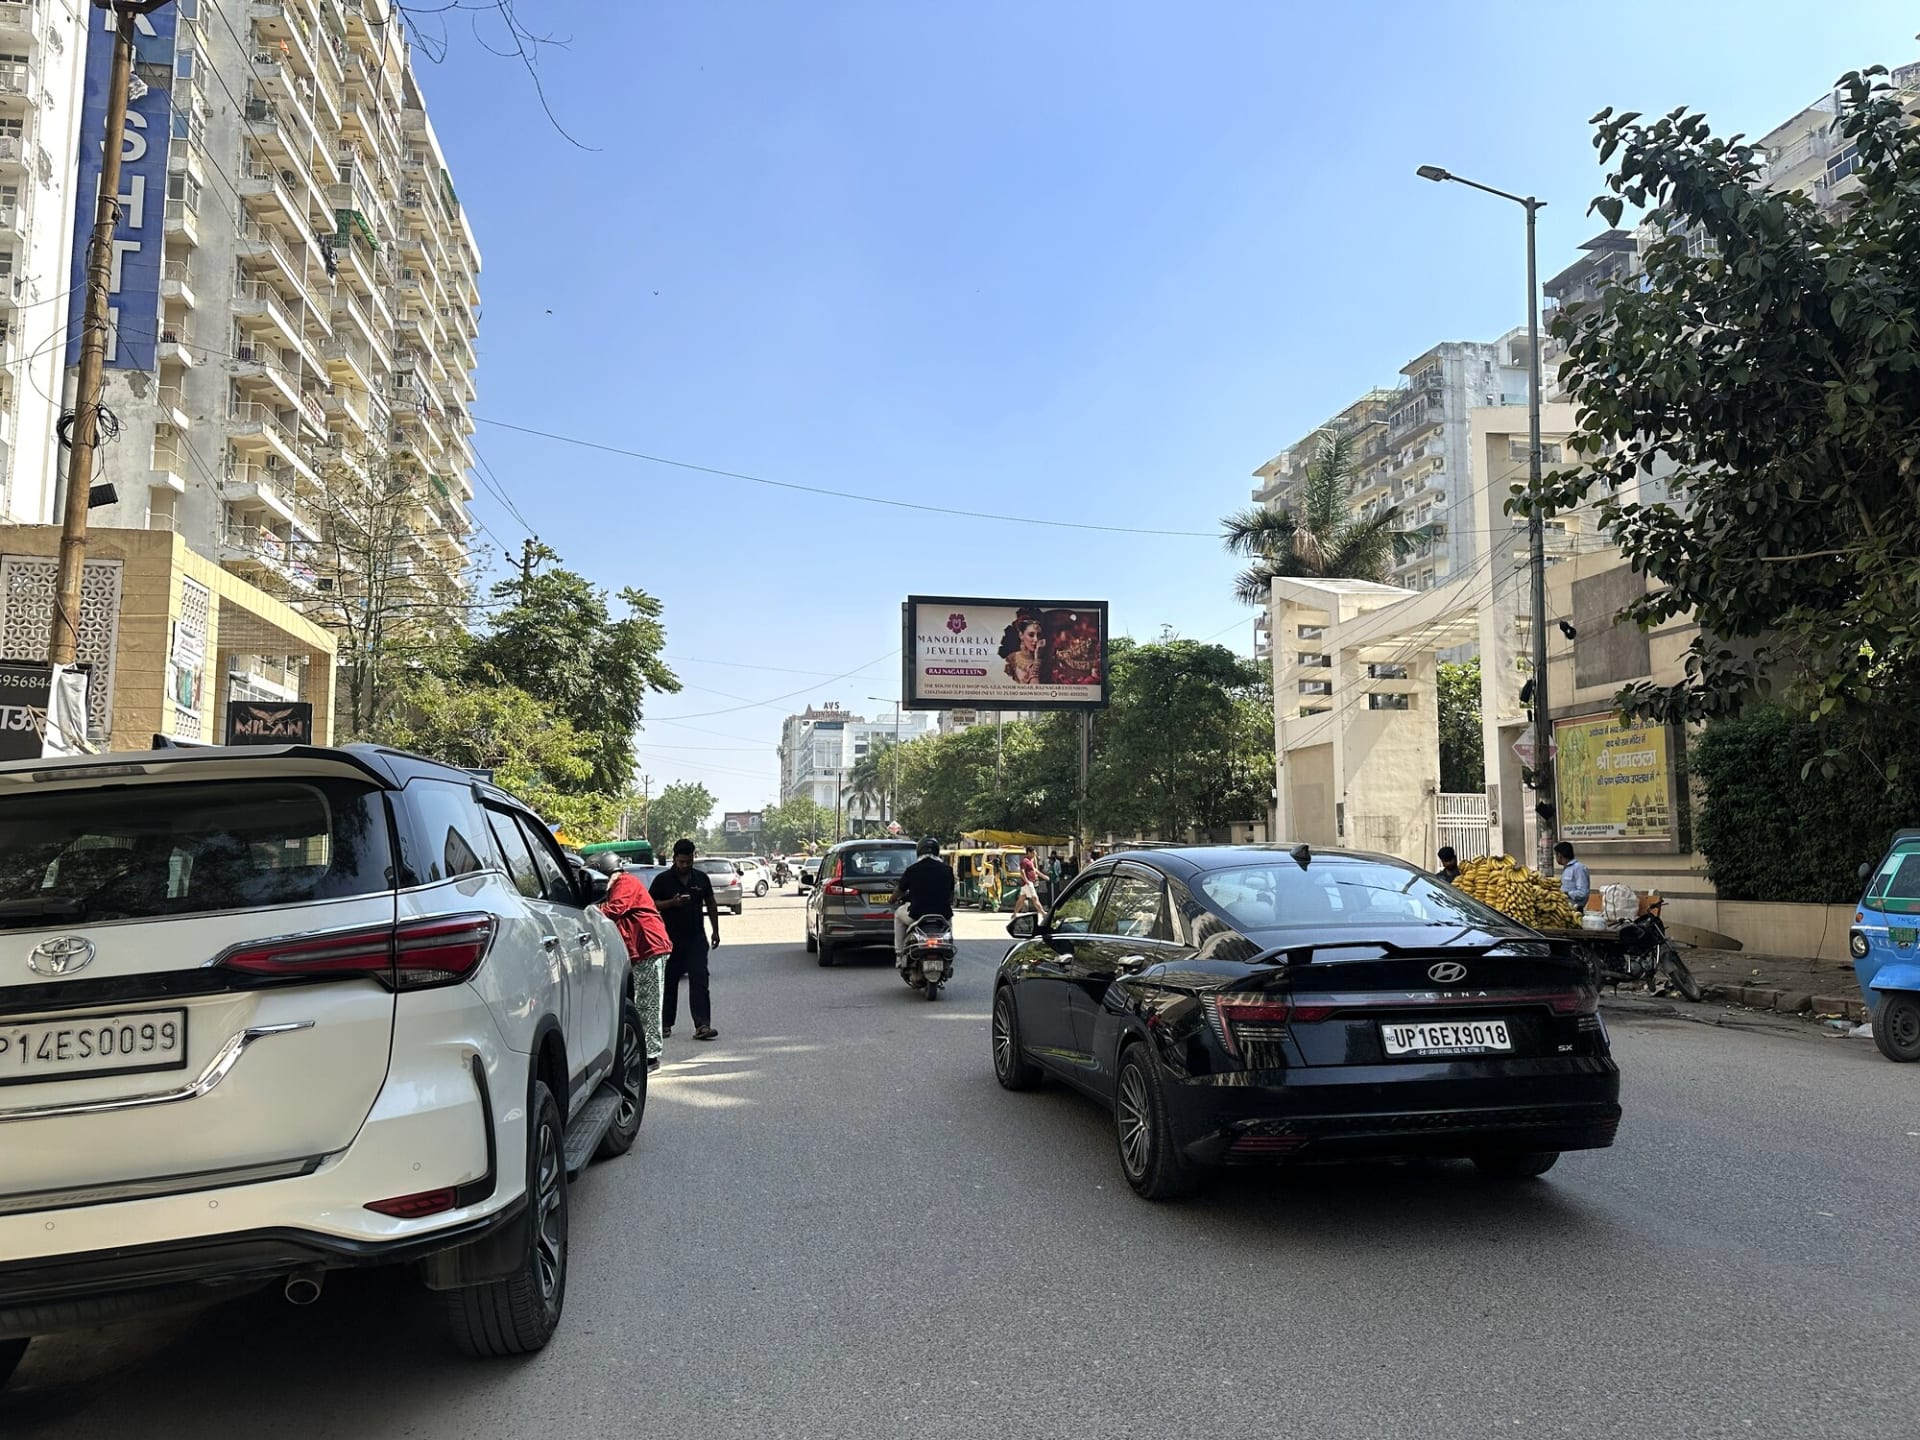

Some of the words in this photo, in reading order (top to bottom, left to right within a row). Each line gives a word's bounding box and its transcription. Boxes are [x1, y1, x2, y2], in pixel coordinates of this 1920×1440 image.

[918, 635, 973, 644] MANOHAR
[976, 636, 996, 645] LAL
[926, 646, 989, 656] JEWELLERY
[235, 717, 304, 736] MILAN
[1597, 749, 1610, 770] श्री
[1613, 750, 1656, 768] रामलला
[1405, 991, 1487, 999] VERNA
[1393, 1025, 1508, 1048] UP16EX9018
[1558, 1044, 1573, 1052] SX
